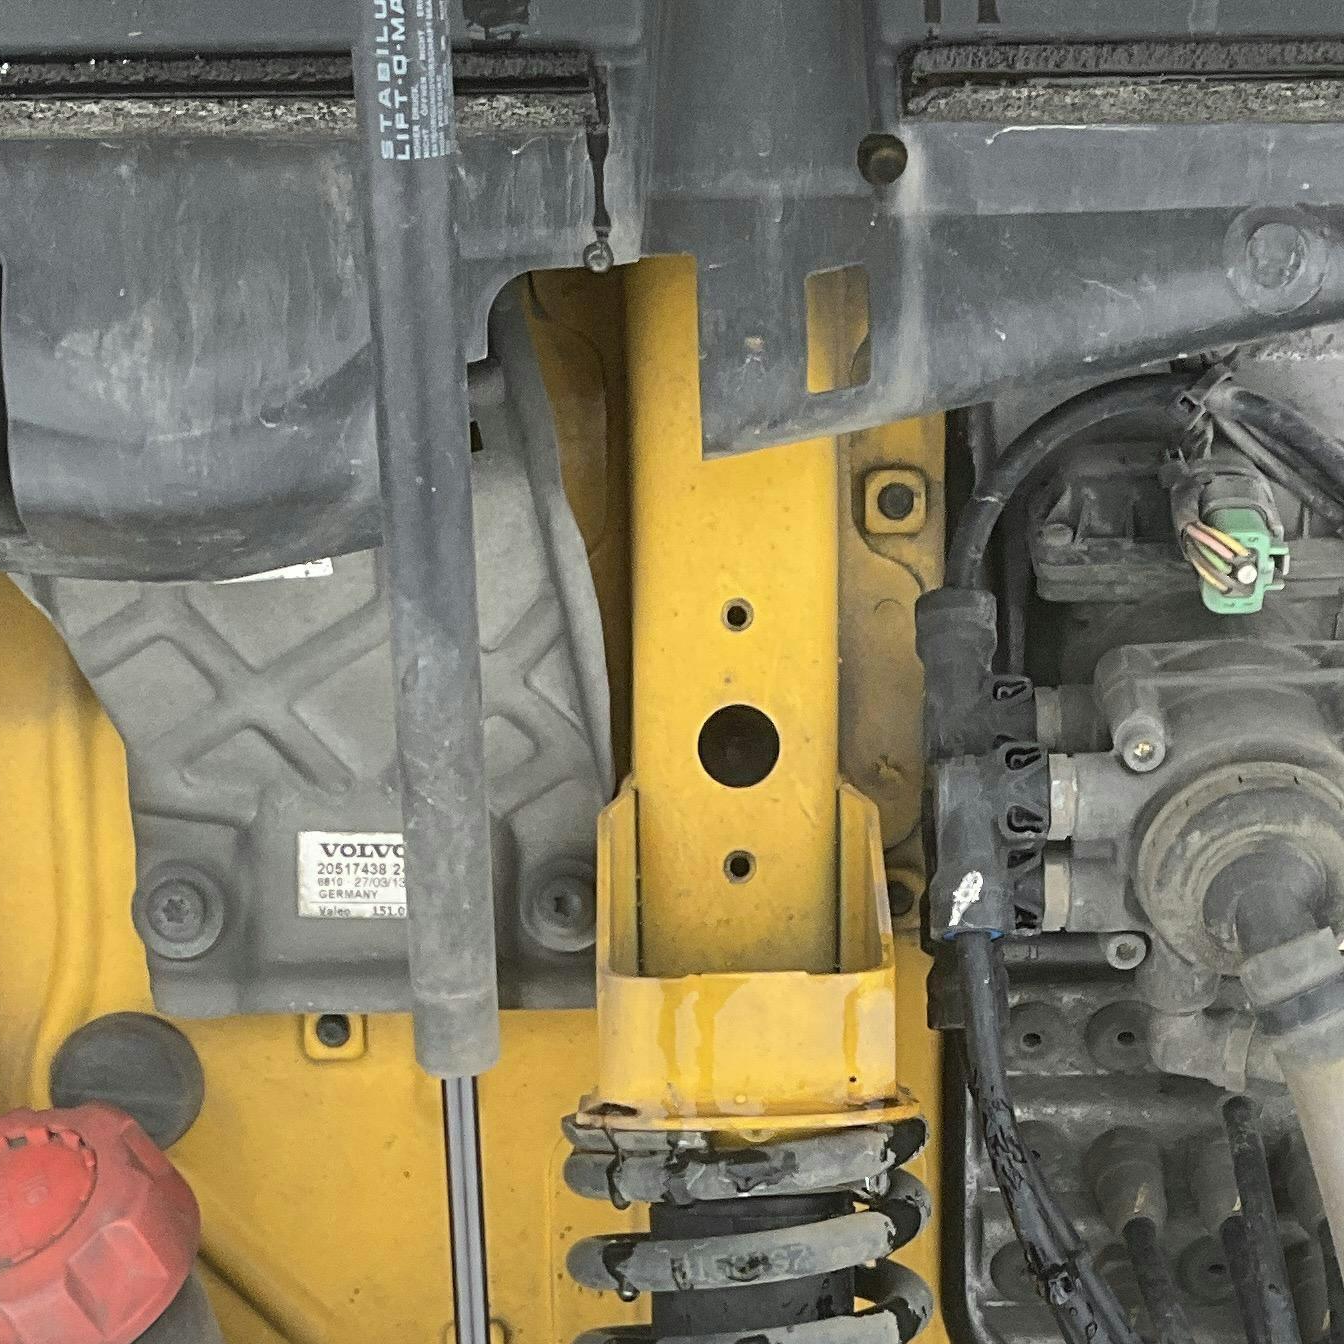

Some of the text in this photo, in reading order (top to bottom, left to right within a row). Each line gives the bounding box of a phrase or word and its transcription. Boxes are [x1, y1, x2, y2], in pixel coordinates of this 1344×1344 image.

[320, 843, 406, 858] VOLVO
[317, 863, 387, 875] 20517438
[319, 889, 378, 899] GERMANY
